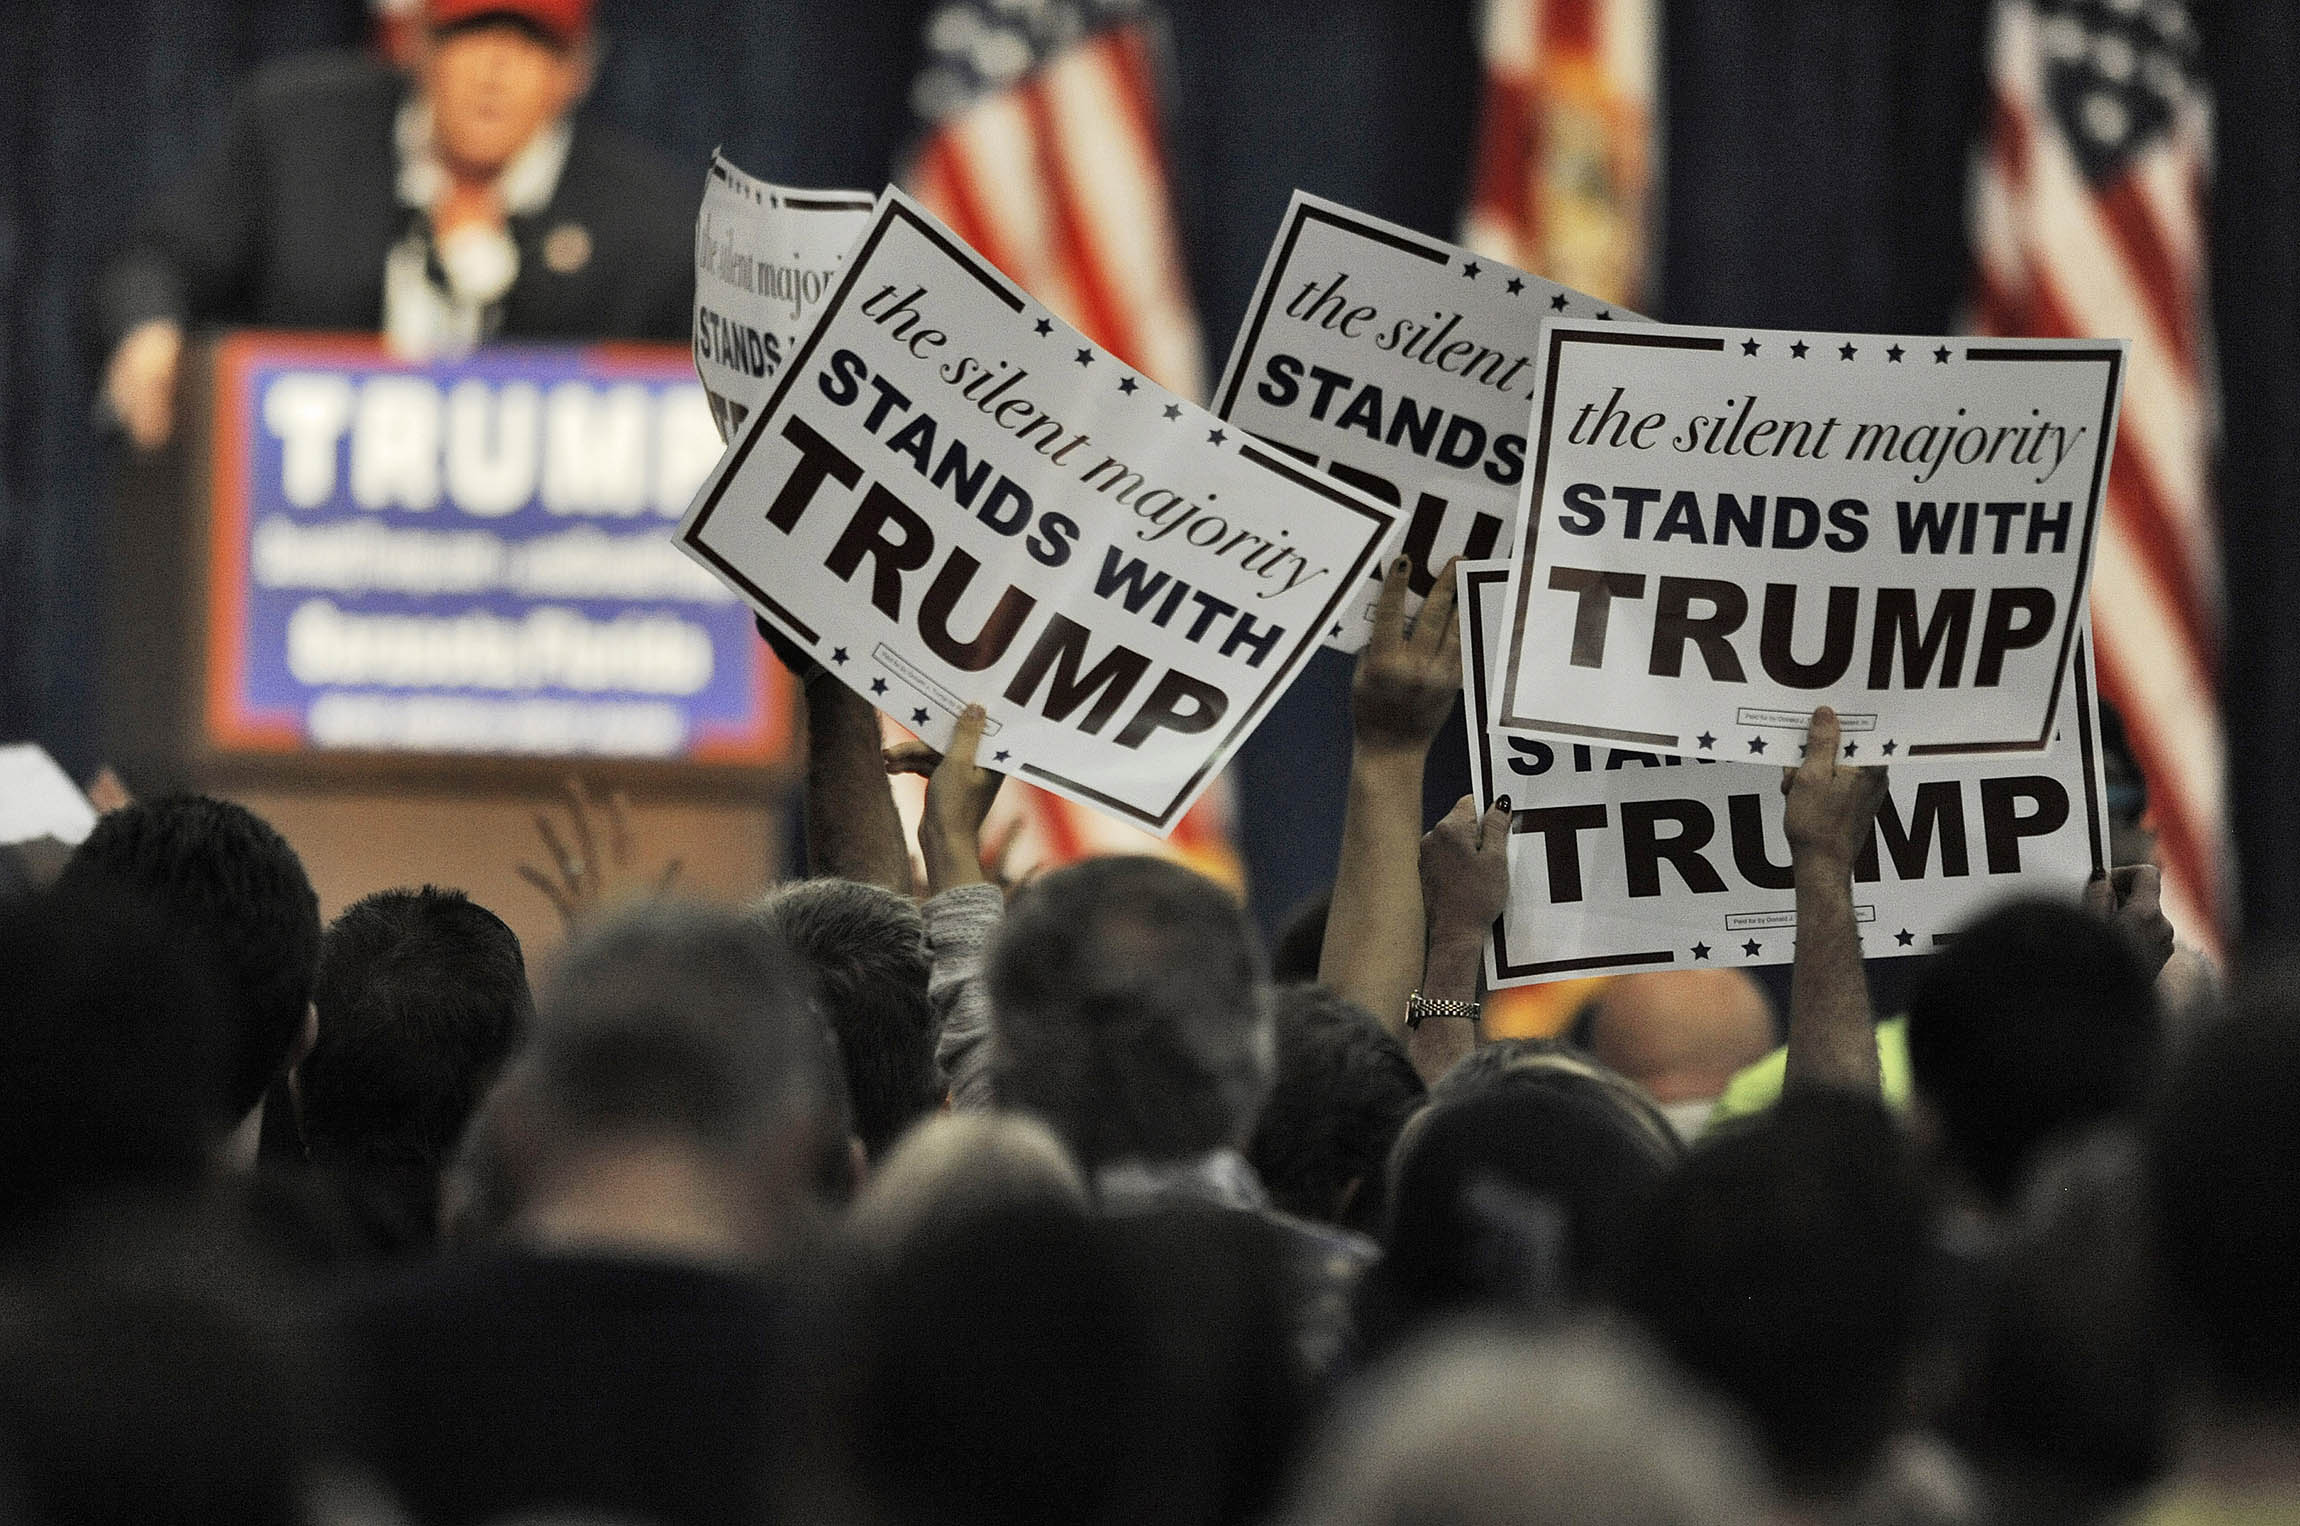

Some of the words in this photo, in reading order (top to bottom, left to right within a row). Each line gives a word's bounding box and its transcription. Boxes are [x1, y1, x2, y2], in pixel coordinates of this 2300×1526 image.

[700, 306, 783, 379] STANDS
[757, 251, 843, 321] major
[1285, 272, 1378, 339] the
[1375, 311, 1534, 393] silent
[860, 283, 948, 361] the
[939, 359, 1090, 468] silent
[1081, 455, 1330, 600] majority
[1257, 353, 1528, 487] STANDS
[1567, 386, 1667, 451] the
[1673, 395, 1840, 461] silent
[1845, 408, 2088, 484] majority
[818, 349, 1081, 569] STANDS
[1093, 546, 1287, 670] WITH
[1558, 482, 1870, 554] STANDS
[1896, 501, 2073, 556] WITH
[761, 414, 1231, 751] TRUMP
[1548, 565, 2057, 692] TRUMP
[1512, 774, 2071, 906] TRUMP
